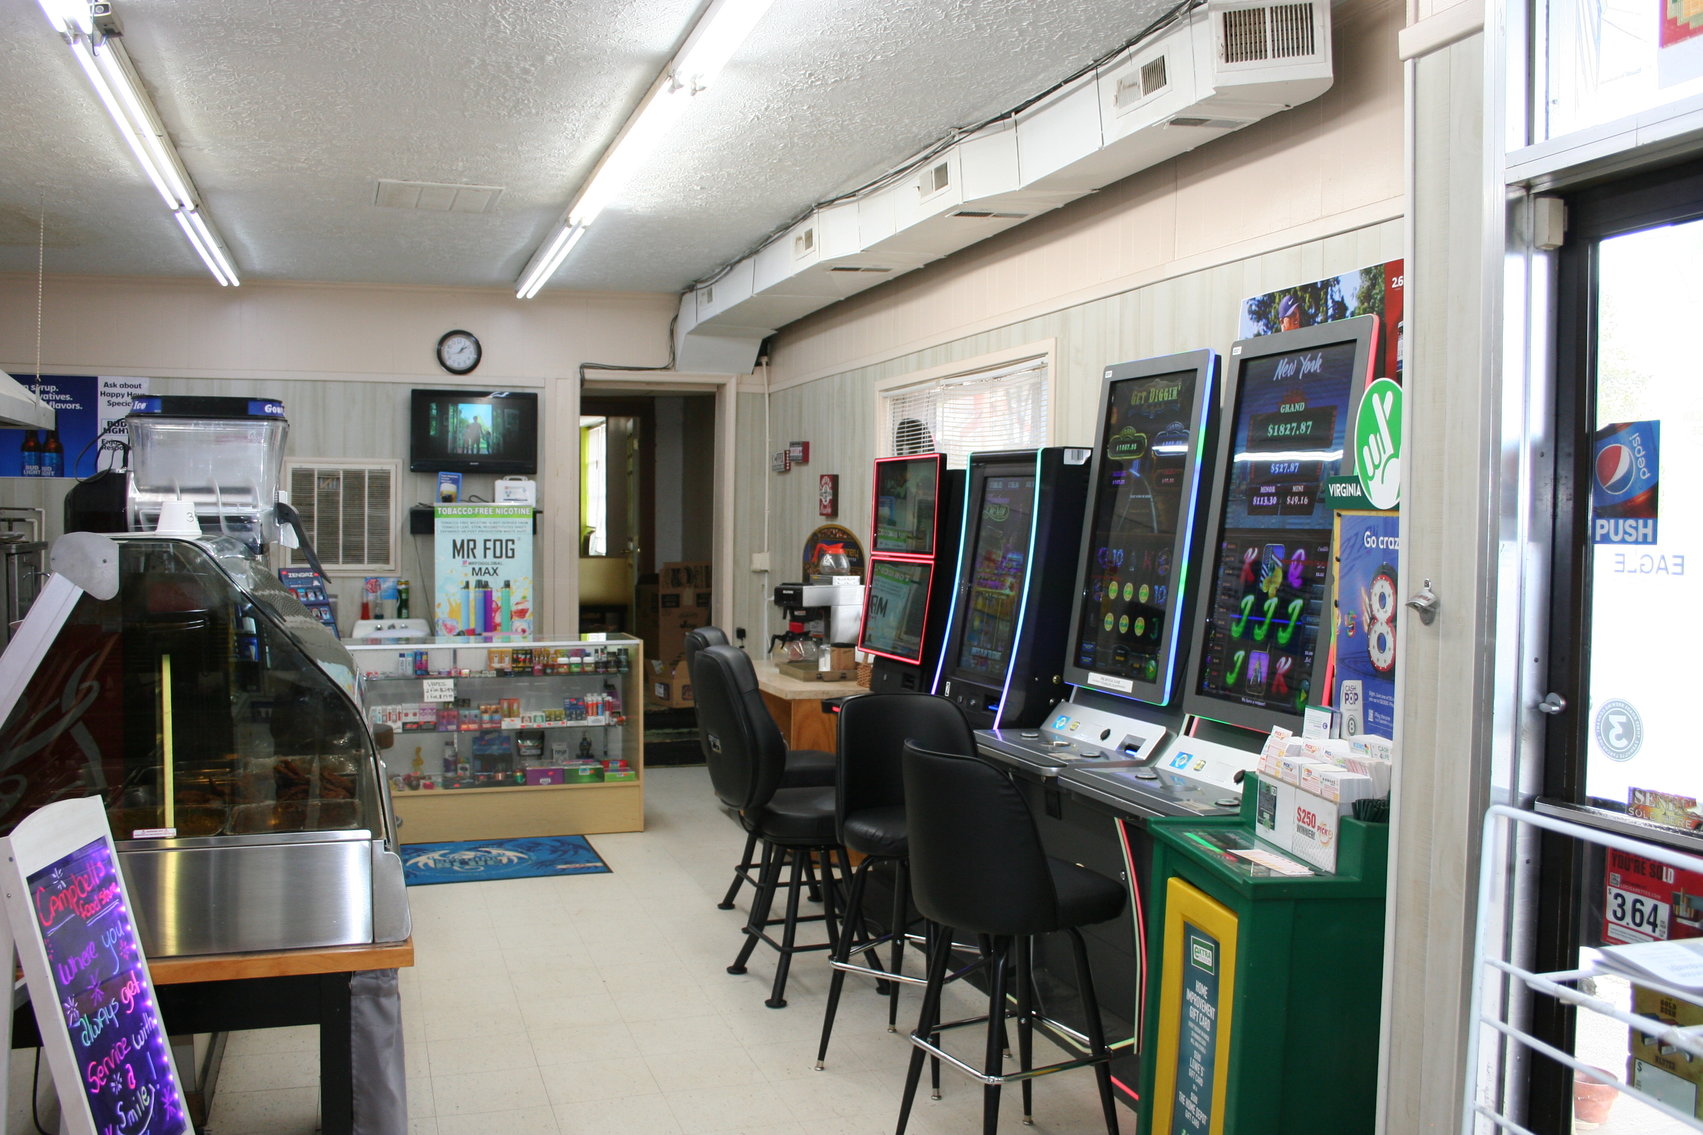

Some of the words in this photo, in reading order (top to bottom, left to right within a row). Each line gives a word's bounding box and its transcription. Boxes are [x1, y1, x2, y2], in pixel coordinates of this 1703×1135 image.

[1273, 358, 1297, 381] New
[1299, 353, 1323, 380] York
[103, 381, 119, 389] Ask
[100, 391, 126, 399] Happy
[133, 401, 147, 410] Ice
[1280, 402, 1305, 414] GRAND
[1267, 421, 1313, 437] $1827.87
[1629, 433, 1651, 480] pepsi
[1270, 462, 1299, 474] $527.87
[1328, 483, 1362, 497] VIRGINIA
[437, 507, 493, 515] TOBACCO-FREE
[495, 507, 531, 515] NICOTINE
[1595, 519, 1654, 543] PUSH
[1364, 531, 1377, 548] Go
[452, 538, 477, 560] MR
[483, 538, 516, 560] FOG
[471, 567, 499, 577] MAX
[1344, 692, 1359, 705] POP
[1296, 806, 1317, 829] $250
[1649, 863, 1675, 884] SOLD
[121, 969, 141, 1014] get
[87, 1037, 131, 1094] Service
[132, 1012, 156, 1050] with
